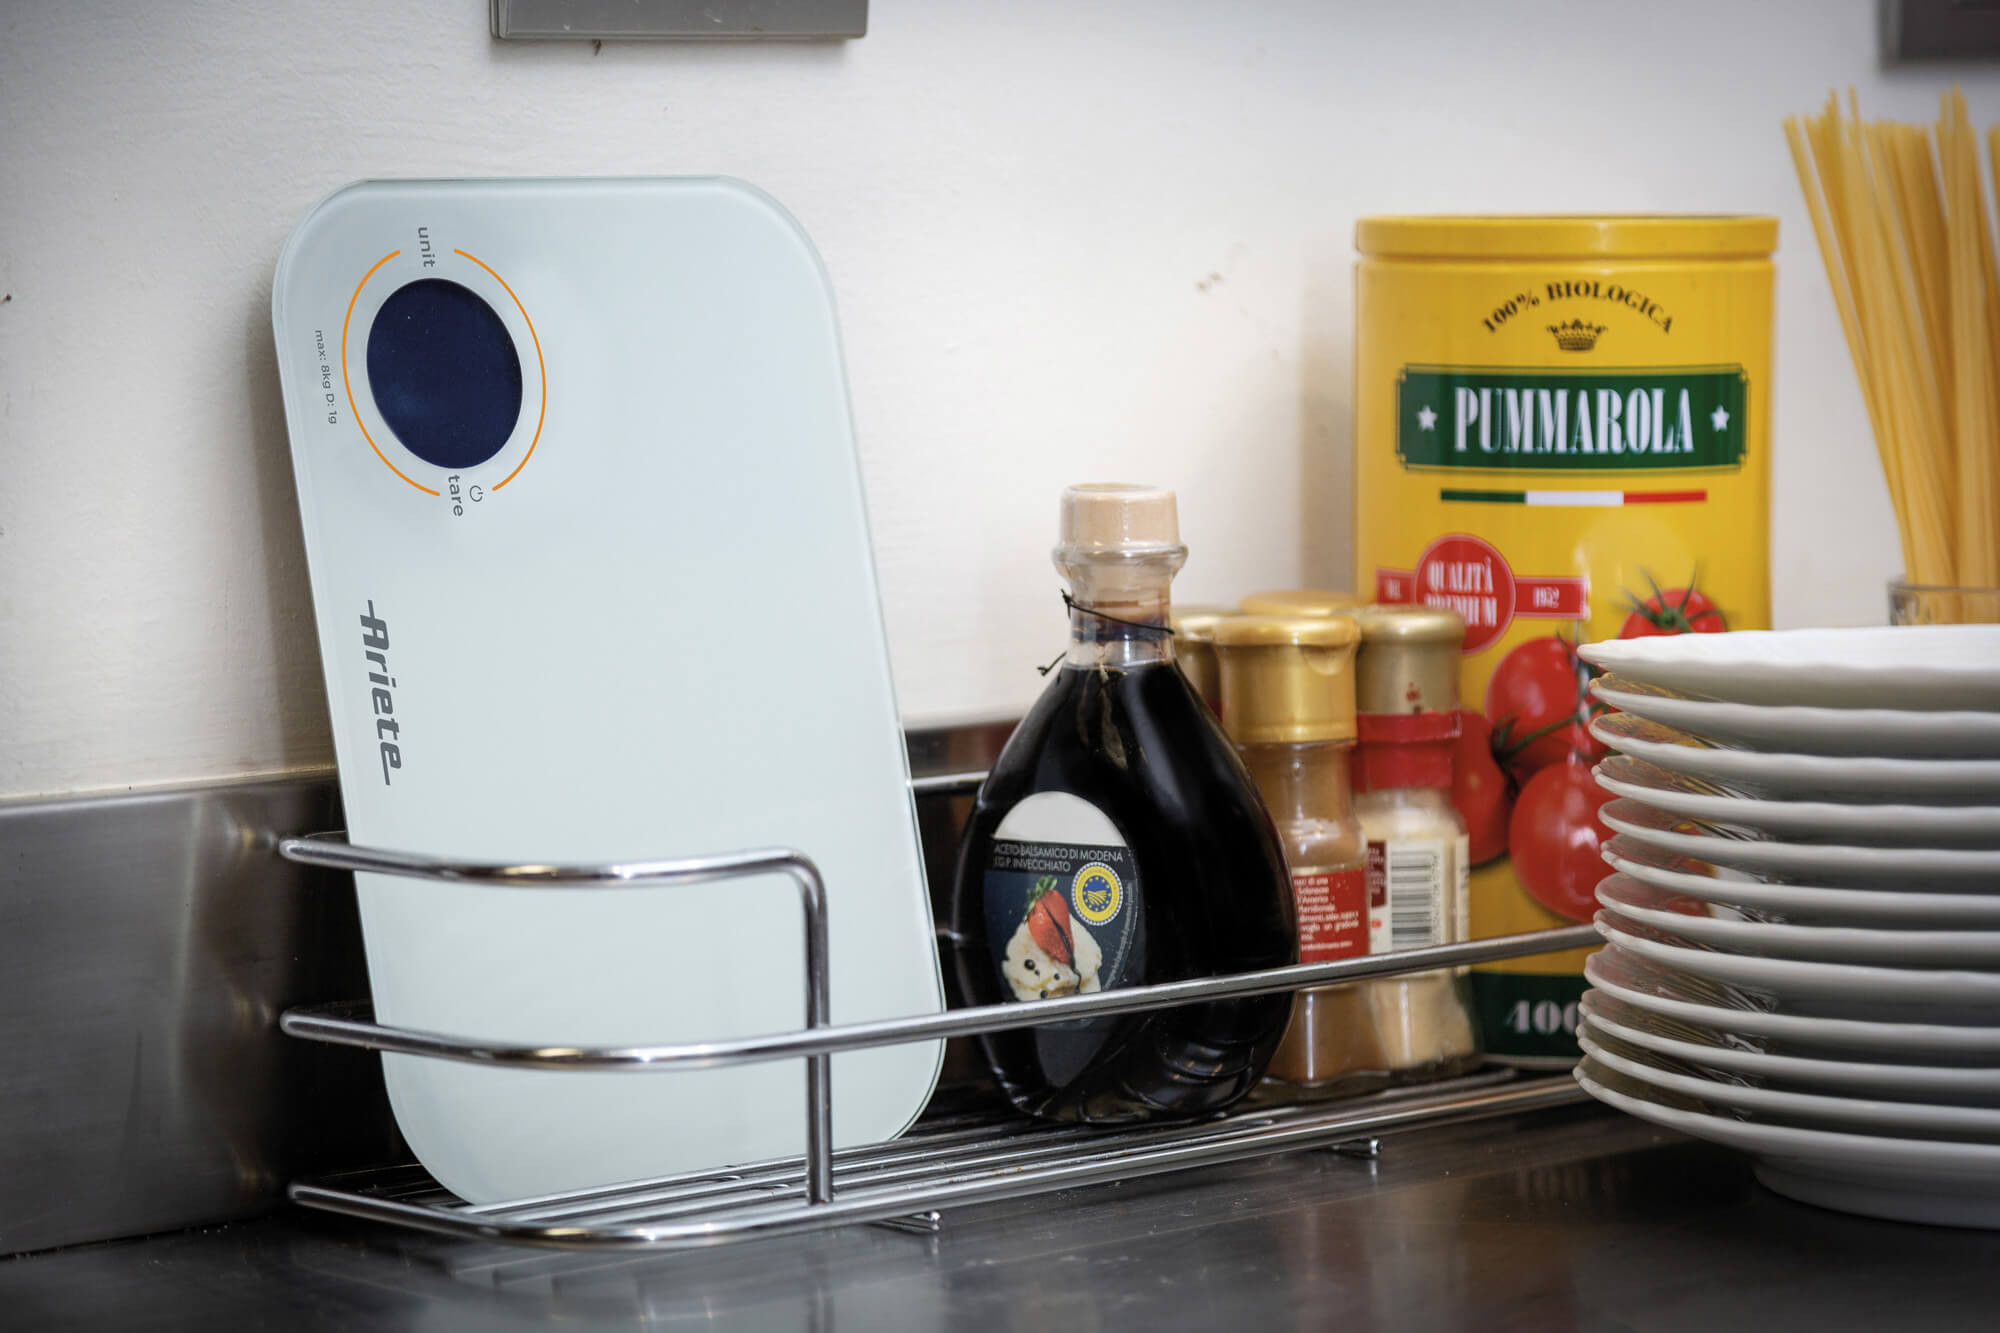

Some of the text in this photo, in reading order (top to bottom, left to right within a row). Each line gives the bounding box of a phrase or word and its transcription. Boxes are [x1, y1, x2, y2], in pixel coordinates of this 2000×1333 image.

[418, 227, 435, 267] unit
[1483, 280, 1673, 334] 100% BIOLOGICA
[321, 364, 331, 389] 8kg
[1454, 386, 1695, 454] PUMMAROLA
[448, 474, 463, 517] tare
[359, 599, 402, 786] Ariete
[994, 843, 1124, 863] ACETO BALSAMICO DI MODENA
[1013, 858, 1071, 873] INVECCHIATO
